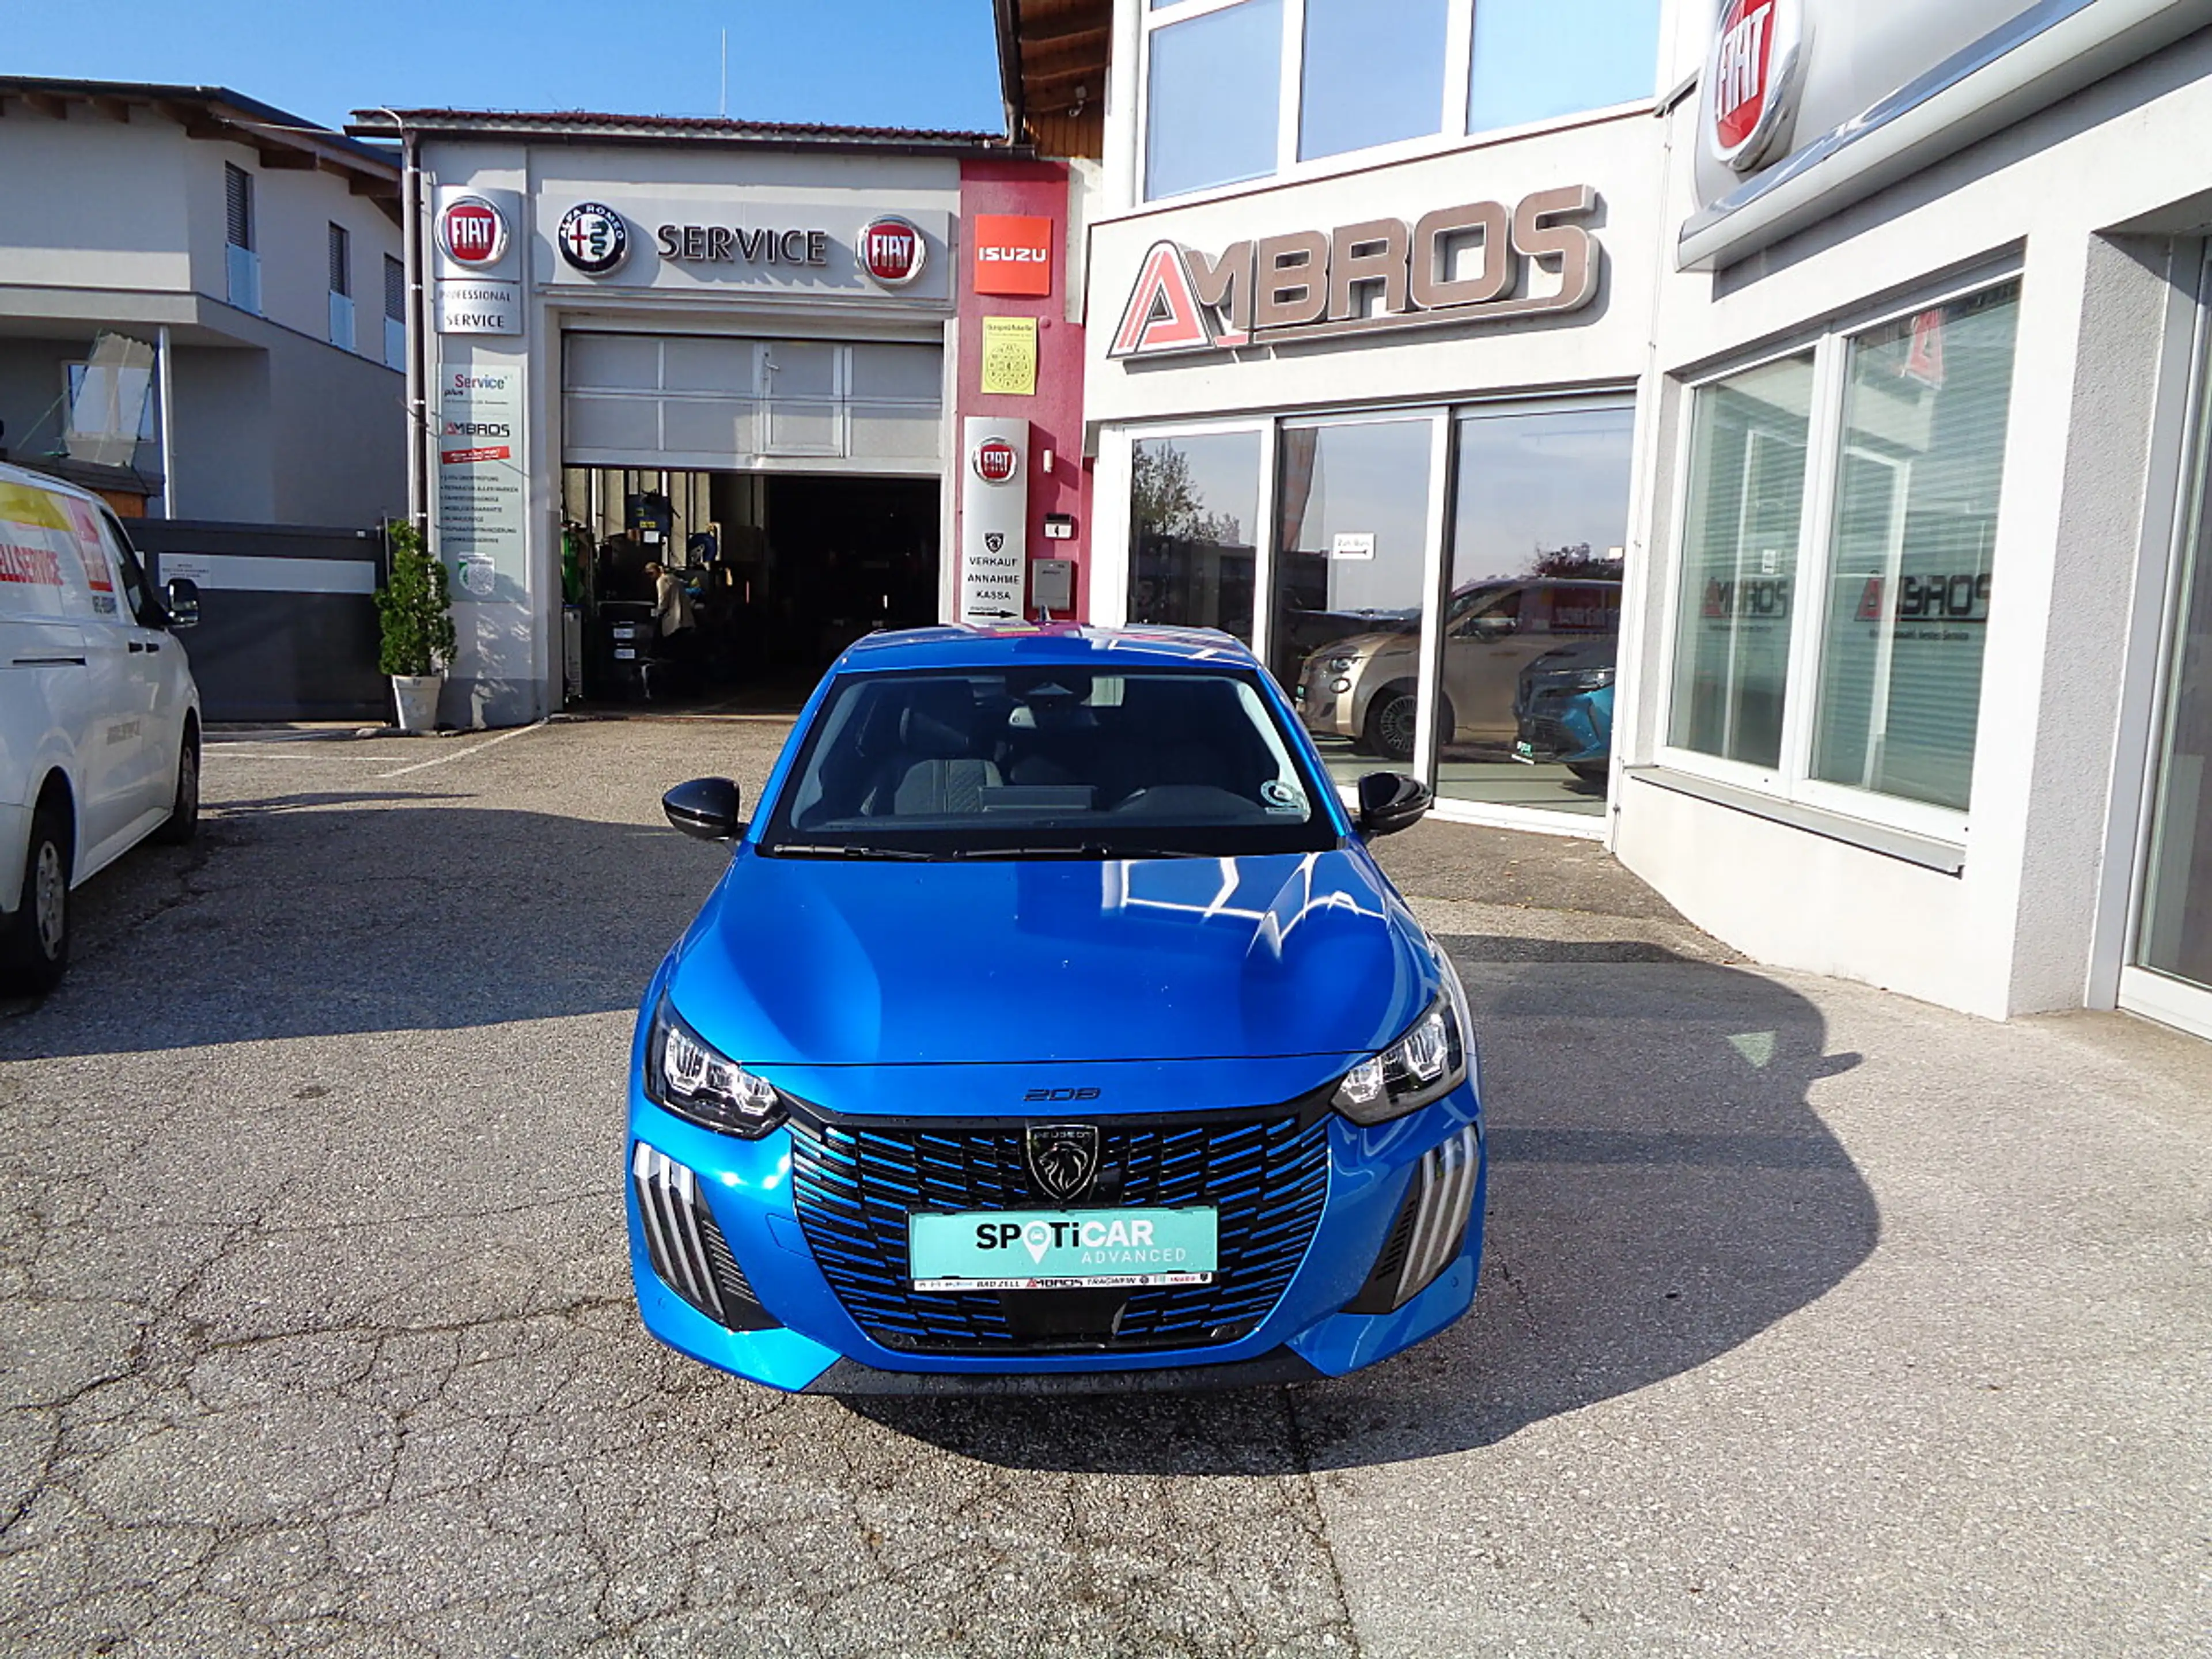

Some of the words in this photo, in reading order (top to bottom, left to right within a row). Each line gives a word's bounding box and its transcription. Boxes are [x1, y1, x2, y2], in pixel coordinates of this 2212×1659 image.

[1715, 1, 1772, 123] FIAT
[451, 217, 492, 249] FIAT
[657, 225, 827, 265] SERVICE
[871, 233, 913, 267] FIAT
[978, 247, 1047, 263] ISUZU
[1105, 183, 1604, 362] AMBROS
[441, 290, 511, 302] PROFESSIONAL
[446, 315, 505, 328] SERVICE
[455, 374, 505, 389] Service
[984, 452, 1009, 472] FIAT
[969, 556, 1018, 568] VERKAUF
[968, 574, 1020, 585] ANNAHME
[976, 590, 1011, 600] KASSA
[1024, 1088, 1101, 1101] 208
[1081, 1248, 1186, 1264] ADVANCED
